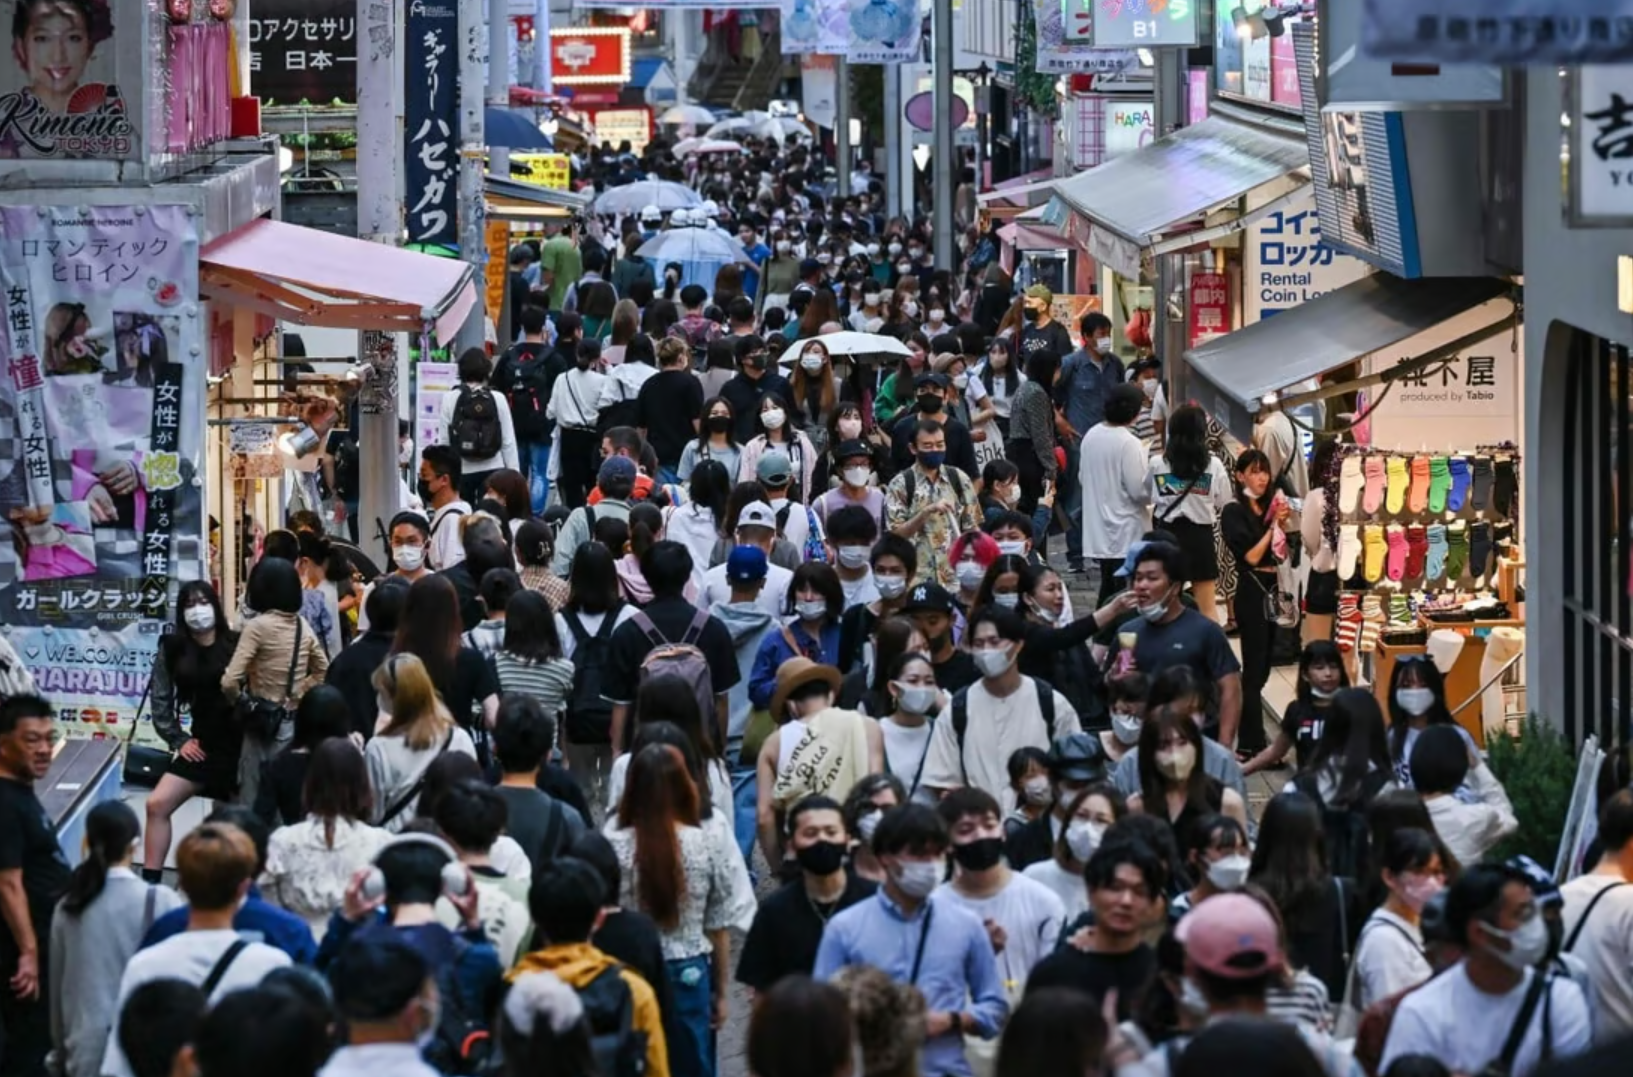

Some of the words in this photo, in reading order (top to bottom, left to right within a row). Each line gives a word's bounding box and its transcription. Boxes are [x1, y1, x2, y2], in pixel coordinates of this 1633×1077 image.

[1133, 20, 1157, 38] B1
[423, 28, 447, 111] ギャラリー
[0, 93, 131, 152] Kimono
[56, 135, 132, 153] TOKYO
[409, 118, 454, 240] ハセガワ
[21, 238, 168, 258] ロマンティック
[52, 262, 140, 283] ヒロイン
[1260, 272, 1312, 286] Rental
[1260, 289, 1298, 303] Coin
[1302, 289, 1335, 302] Lo
[1400, 391, 1448, 403] produced
[1450, 390, 1464, 403] by
[1466, 390, 1495, 401] Tabio
[97, 612, 116, 621] GIRL
[46, 645, 137, 667] WELCOME
